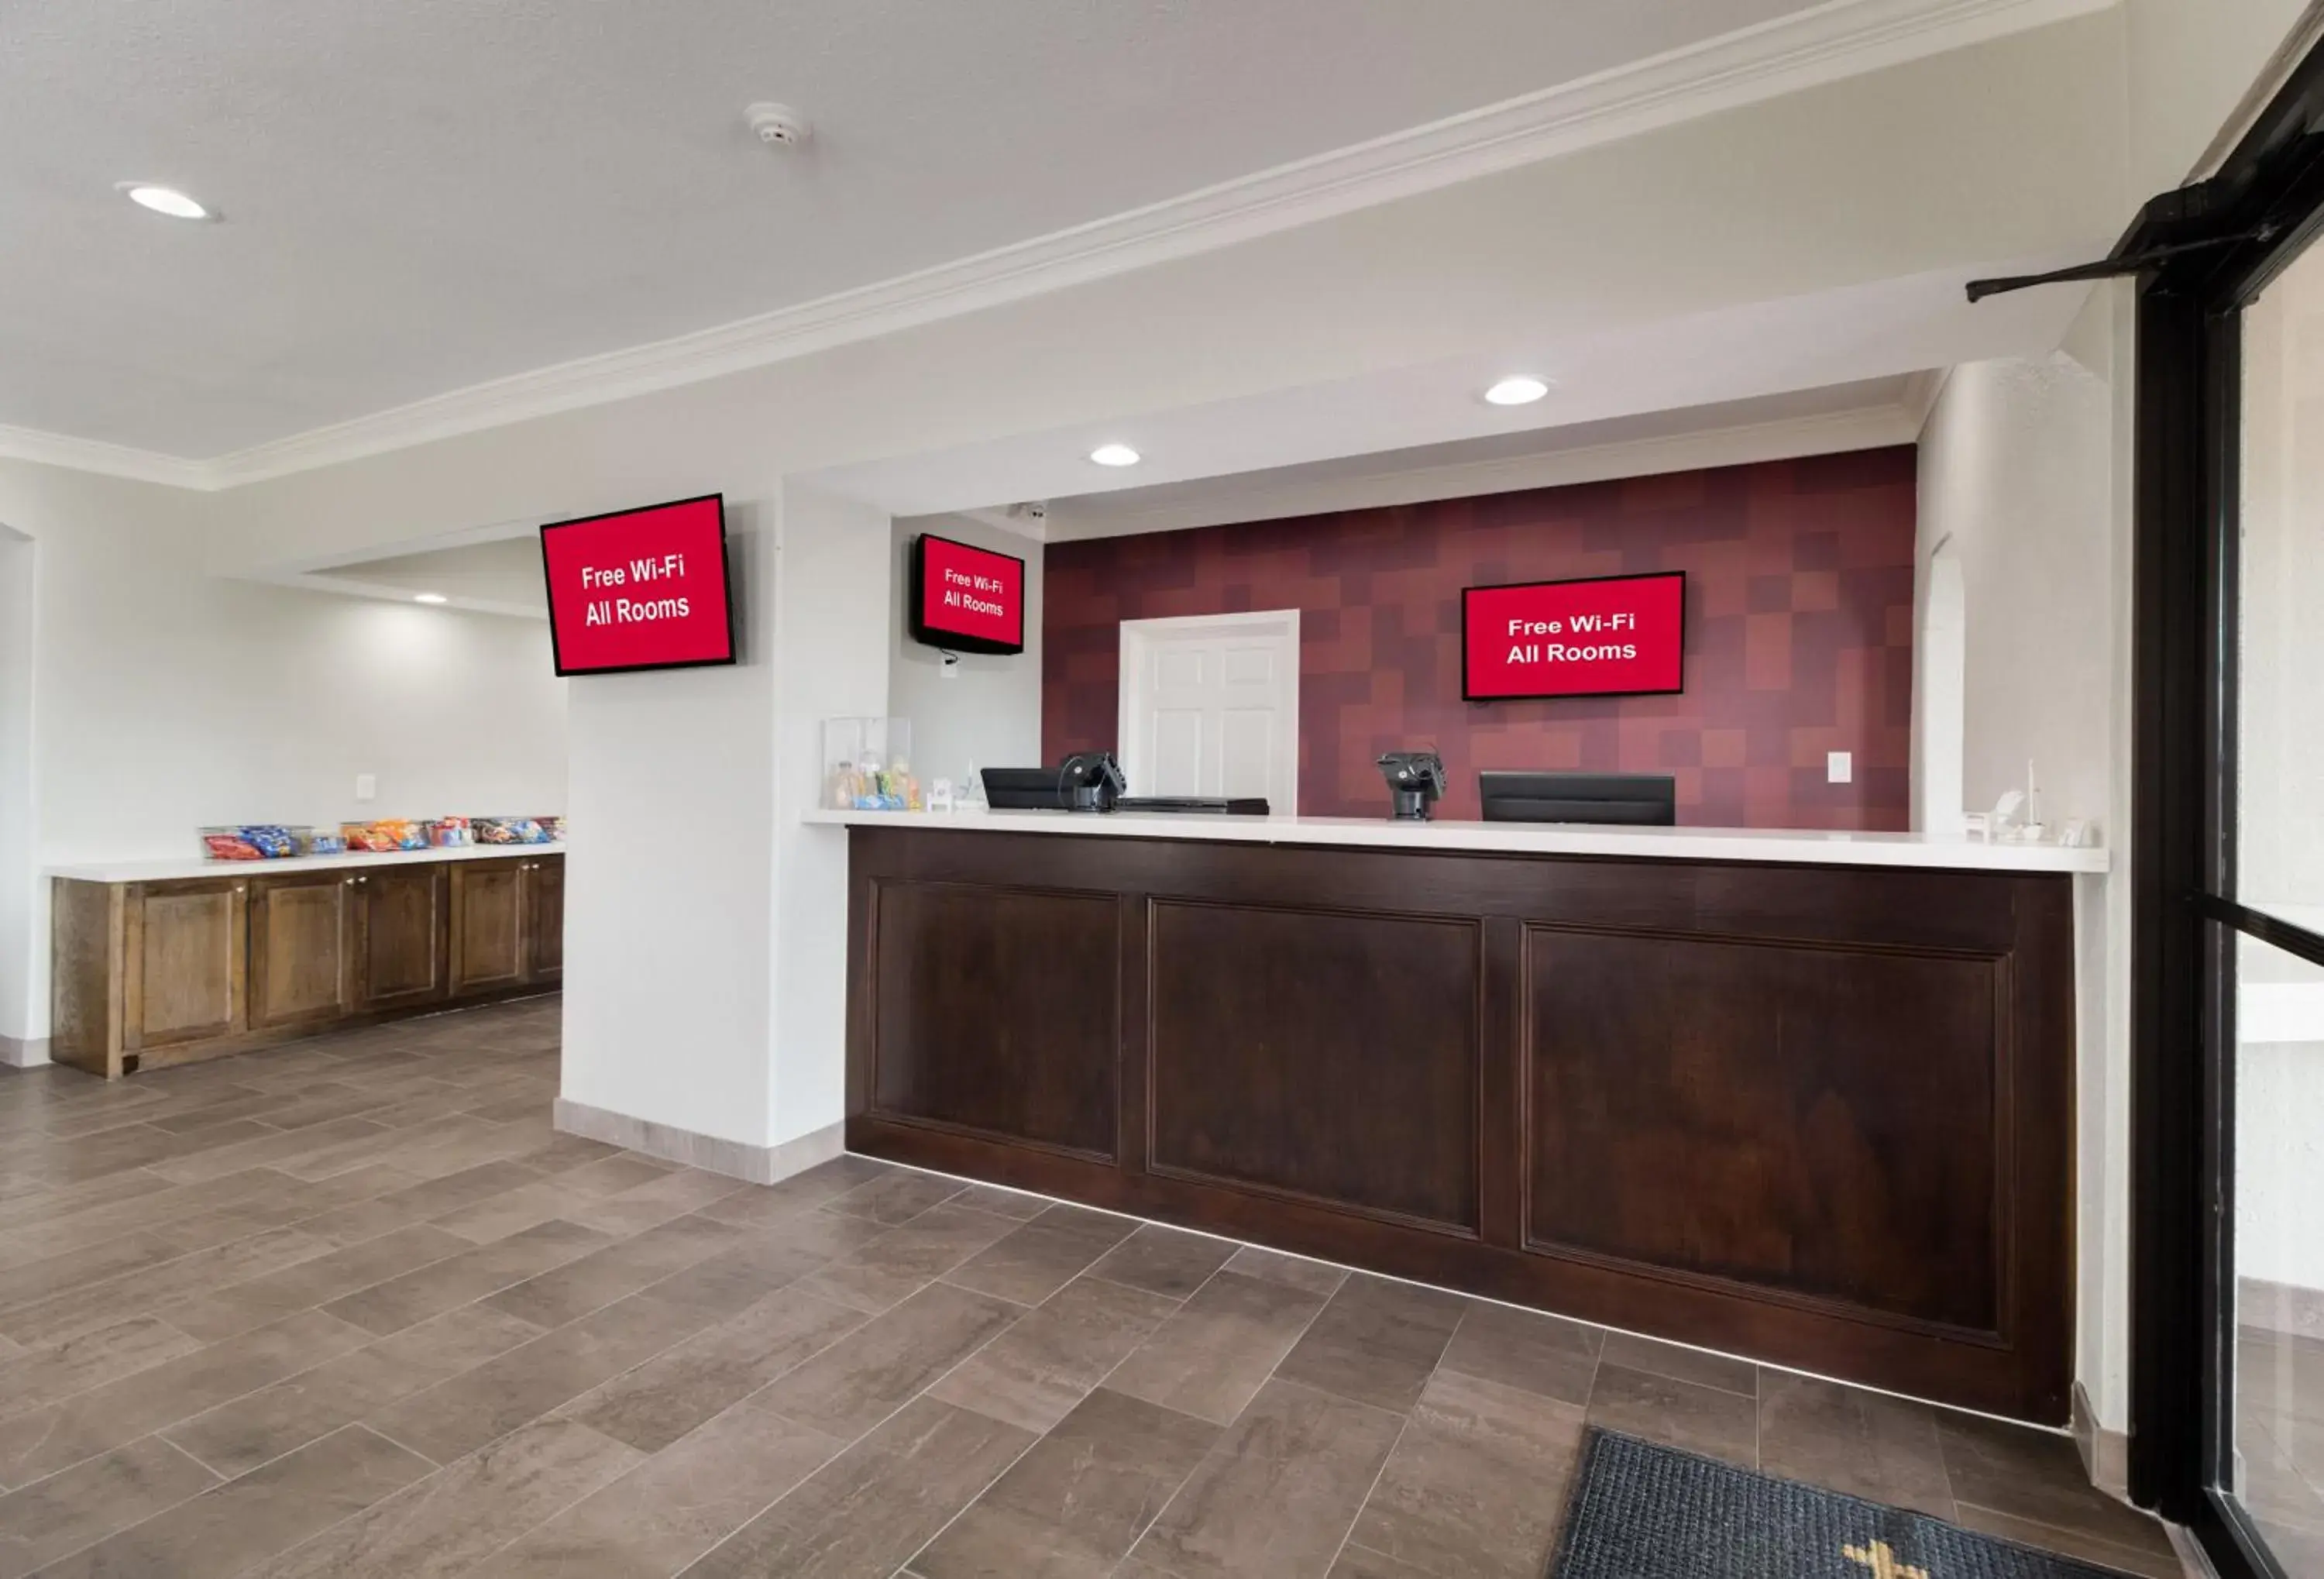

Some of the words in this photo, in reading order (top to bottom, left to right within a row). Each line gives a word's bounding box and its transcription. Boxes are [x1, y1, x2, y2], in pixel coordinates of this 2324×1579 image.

[582, 566, 625, 590] Free
[629, 554, 684, 583] Wi-Fi
[944, 568, 971, 587] Free
[974, 574, 1003, 594] Wi-Fi
[586, 600, 611, 627] All
[616, 597, 689, 624] Rooms
[944, 590, 961, 607] All
[963, 593, 1003, 617] Rooms
[1508, 619, 1563, 636] Free
[1569, 613, 1635, 633] Wi-Fi
[1507, 644, 1539, 664] All
[1547, 643, 1637, 662] Rooms
